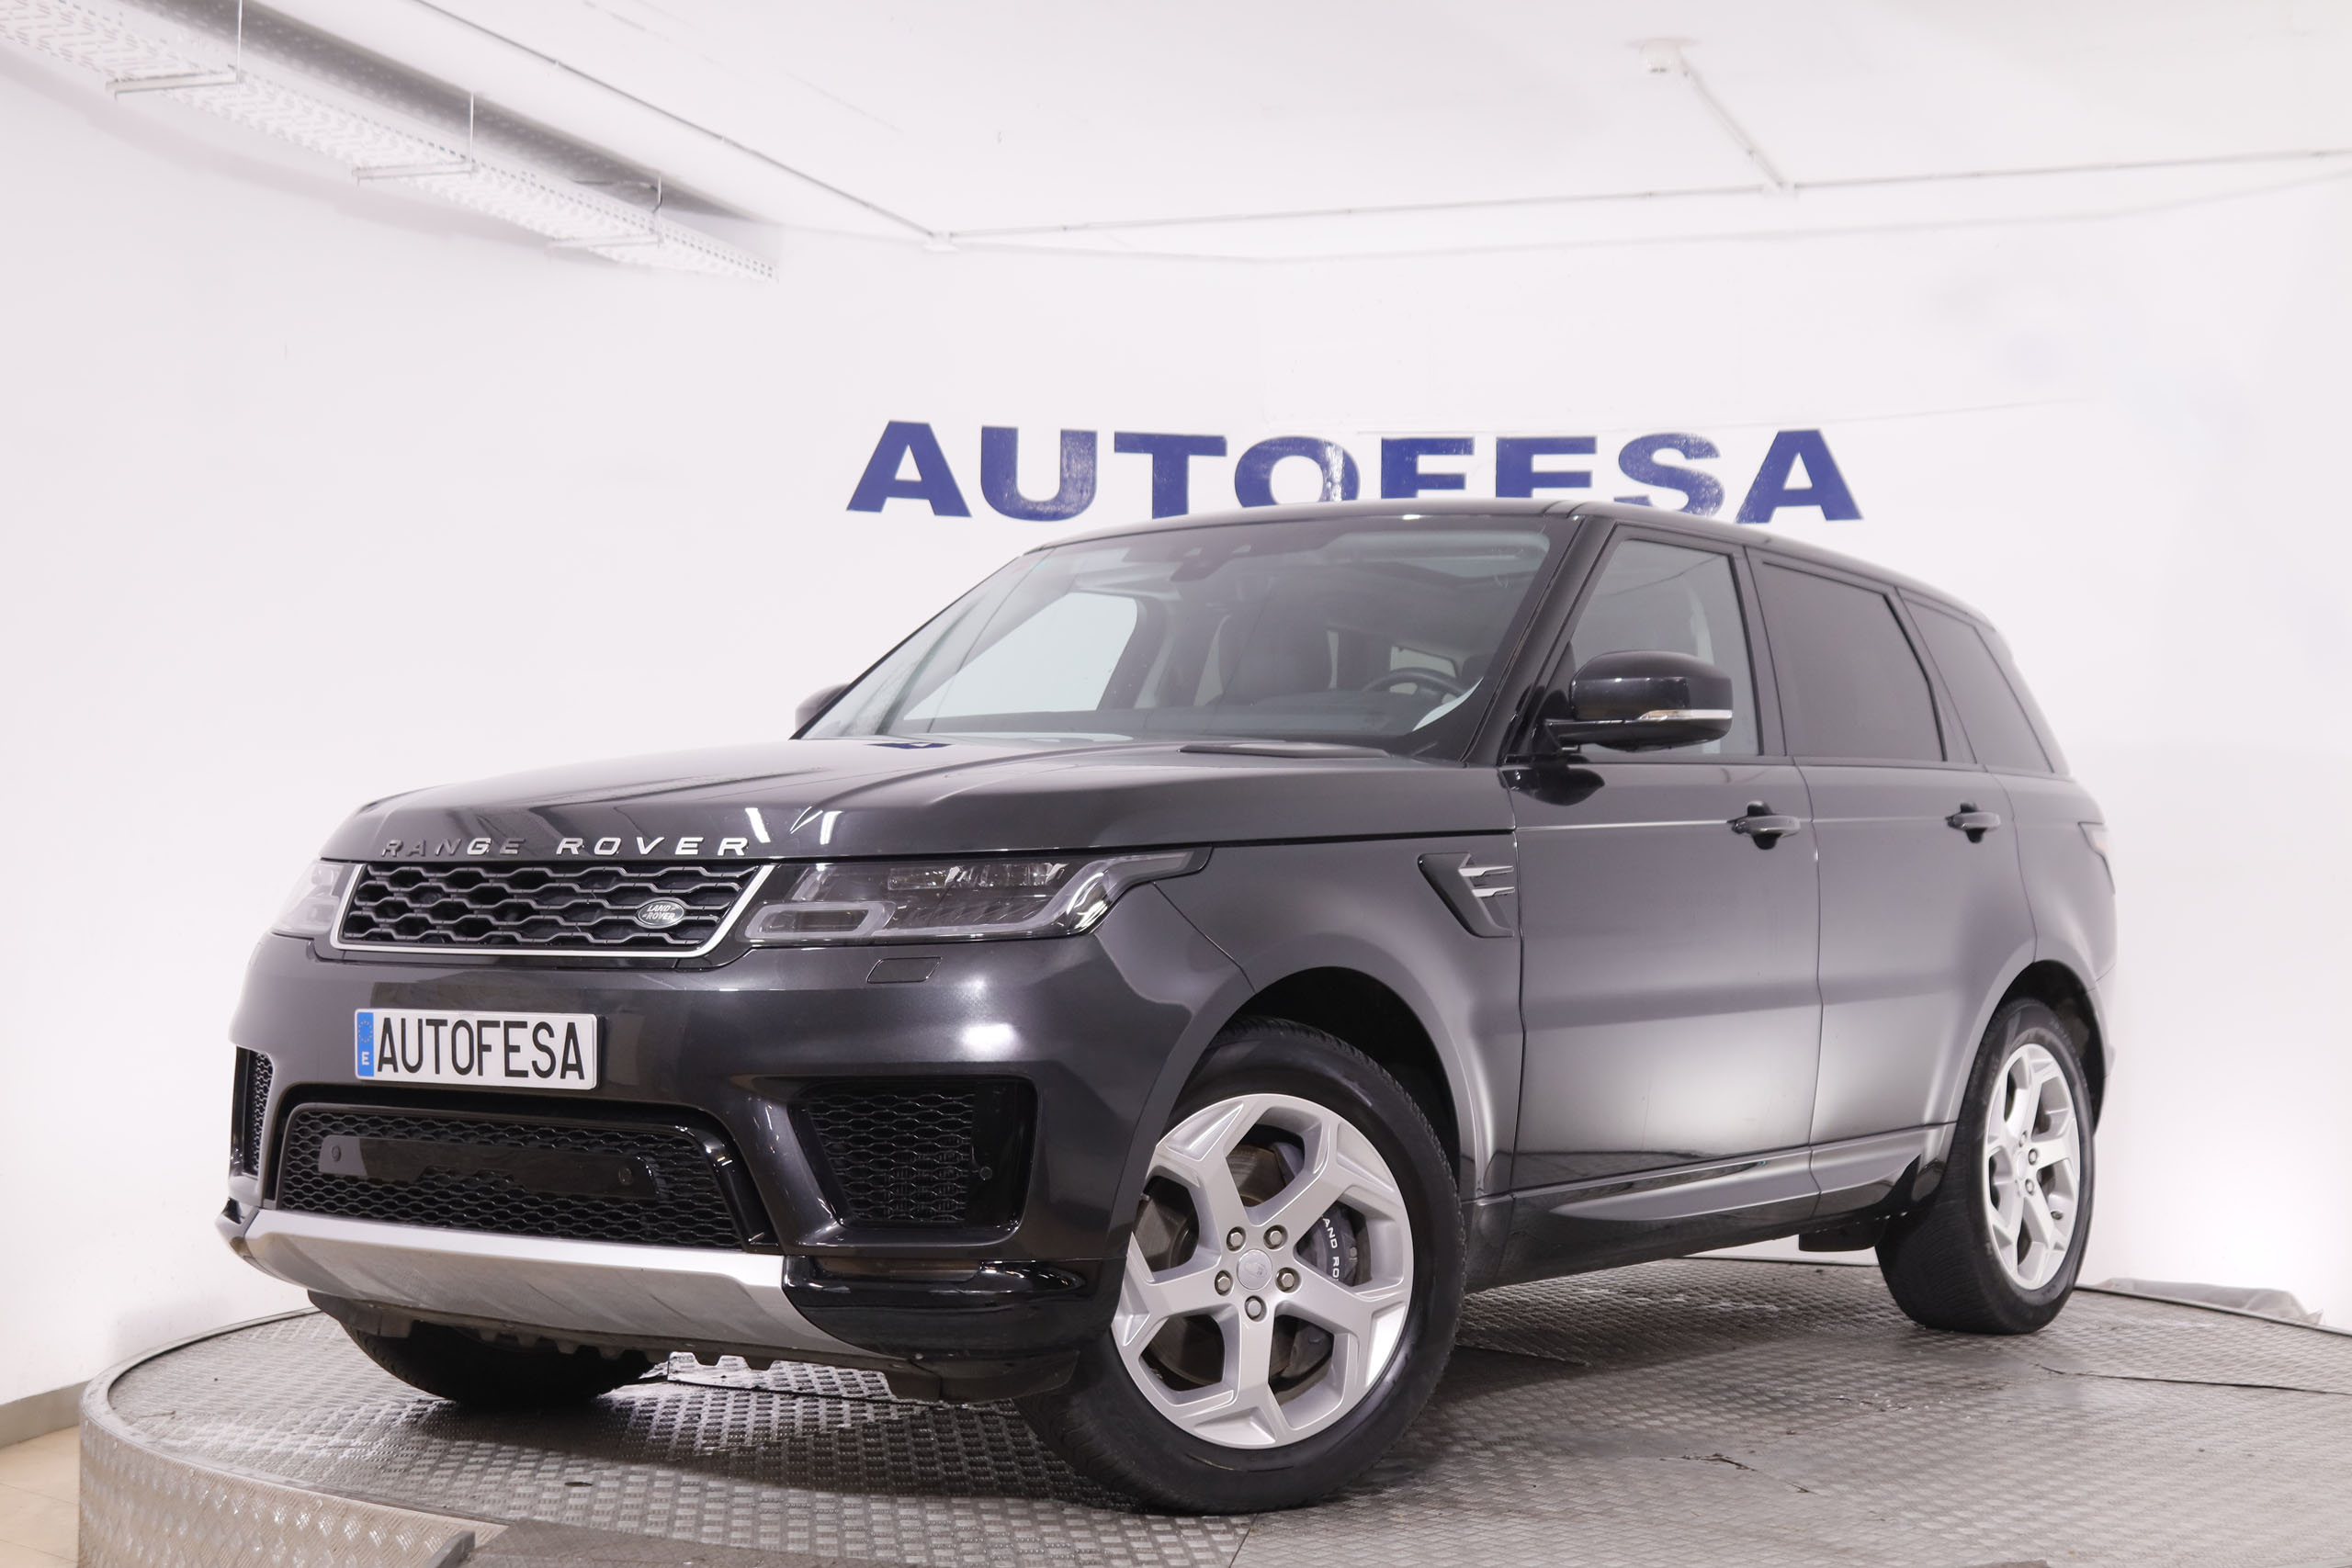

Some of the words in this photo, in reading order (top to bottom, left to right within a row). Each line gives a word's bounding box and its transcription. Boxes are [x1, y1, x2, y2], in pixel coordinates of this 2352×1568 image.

[846, 420, 1863, 524] AUTOFESA
[381, 837, 526, 858] RANGE
[556, 836, 751, 857] ROVER
[645, 911, 676, 920] ROVER
[647, 904, 672, 912] LAND
[361, 1051, 370, 1066] E
[377, 1016, 585, 1080] AUTOFESA
[1322, 1217, 1338, 1249] AND
